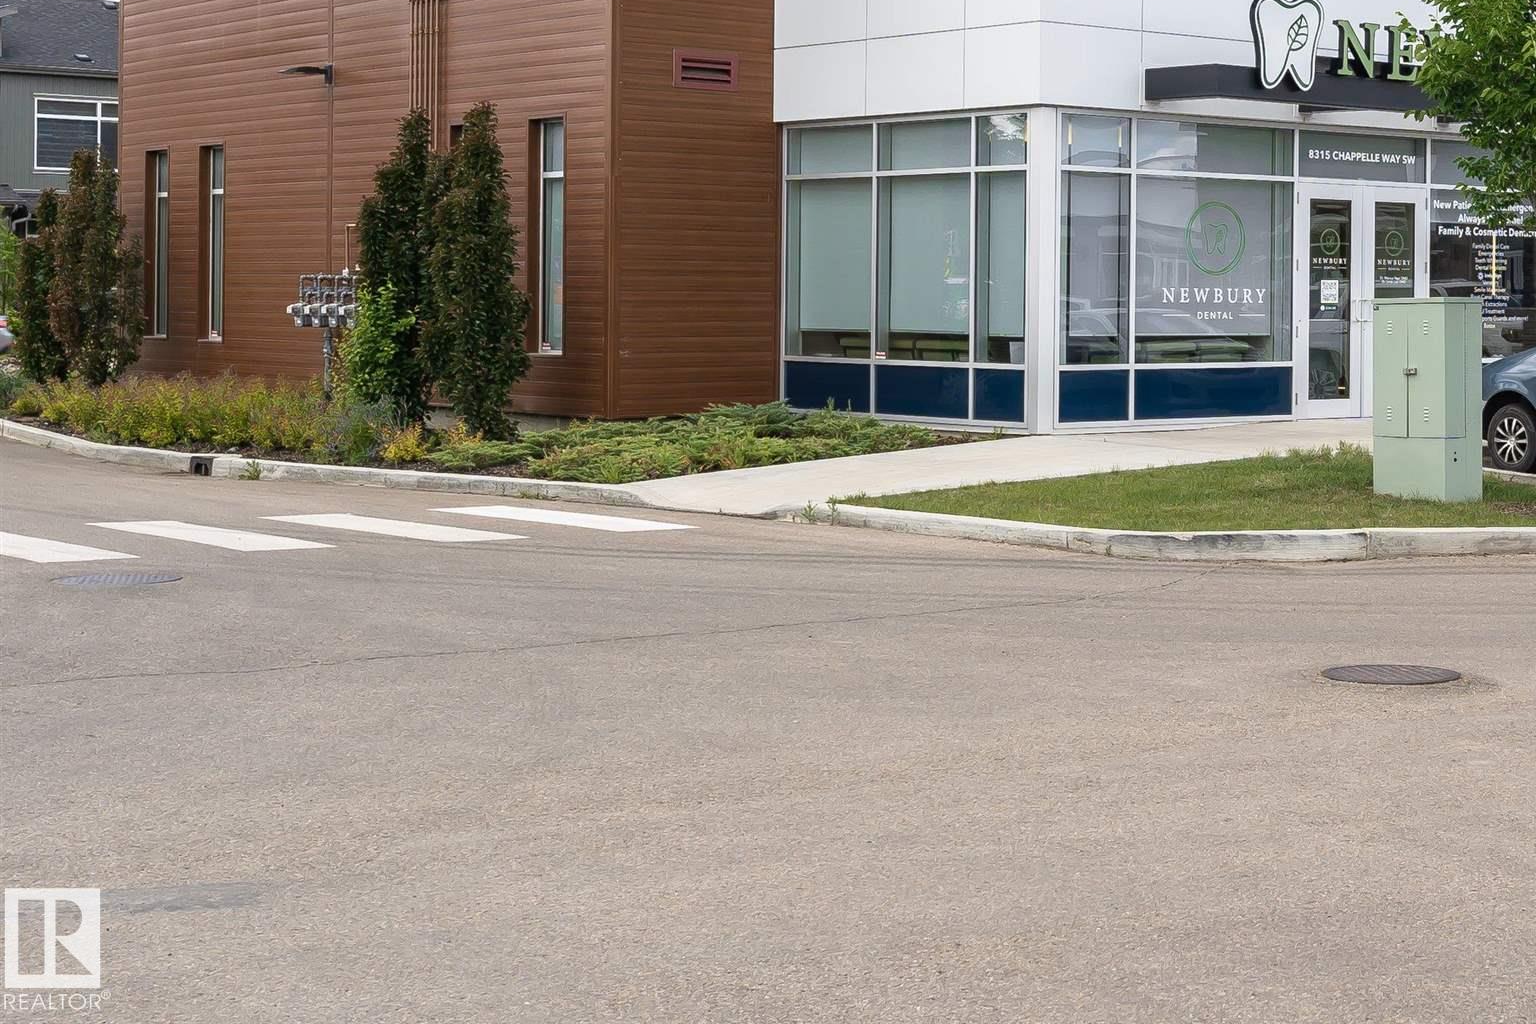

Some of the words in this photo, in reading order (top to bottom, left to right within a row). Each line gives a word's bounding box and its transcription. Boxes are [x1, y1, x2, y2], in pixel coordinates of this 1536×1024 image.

[1308, 149, 1331, 160] 8315
[1332, 151, 1380, 163] CHAPPELLE
[1381, 153, 1400, 164] WAY
[1402, 154, 1416, 165] SW
[1433, 200, 1452, 209] New
[1458, 214, 1485, 225] Always
[1438, 226, 1464, 238] Family
[1465, 226, 1472, 235] &
[1473, 227, 1507, 236] Cosmetic
[1312, 257, 1347, 265] NEWBURY
[1162, 287, 1267, 305] NEWBURY
[1196, 310, 1234, 321] DENTAL
